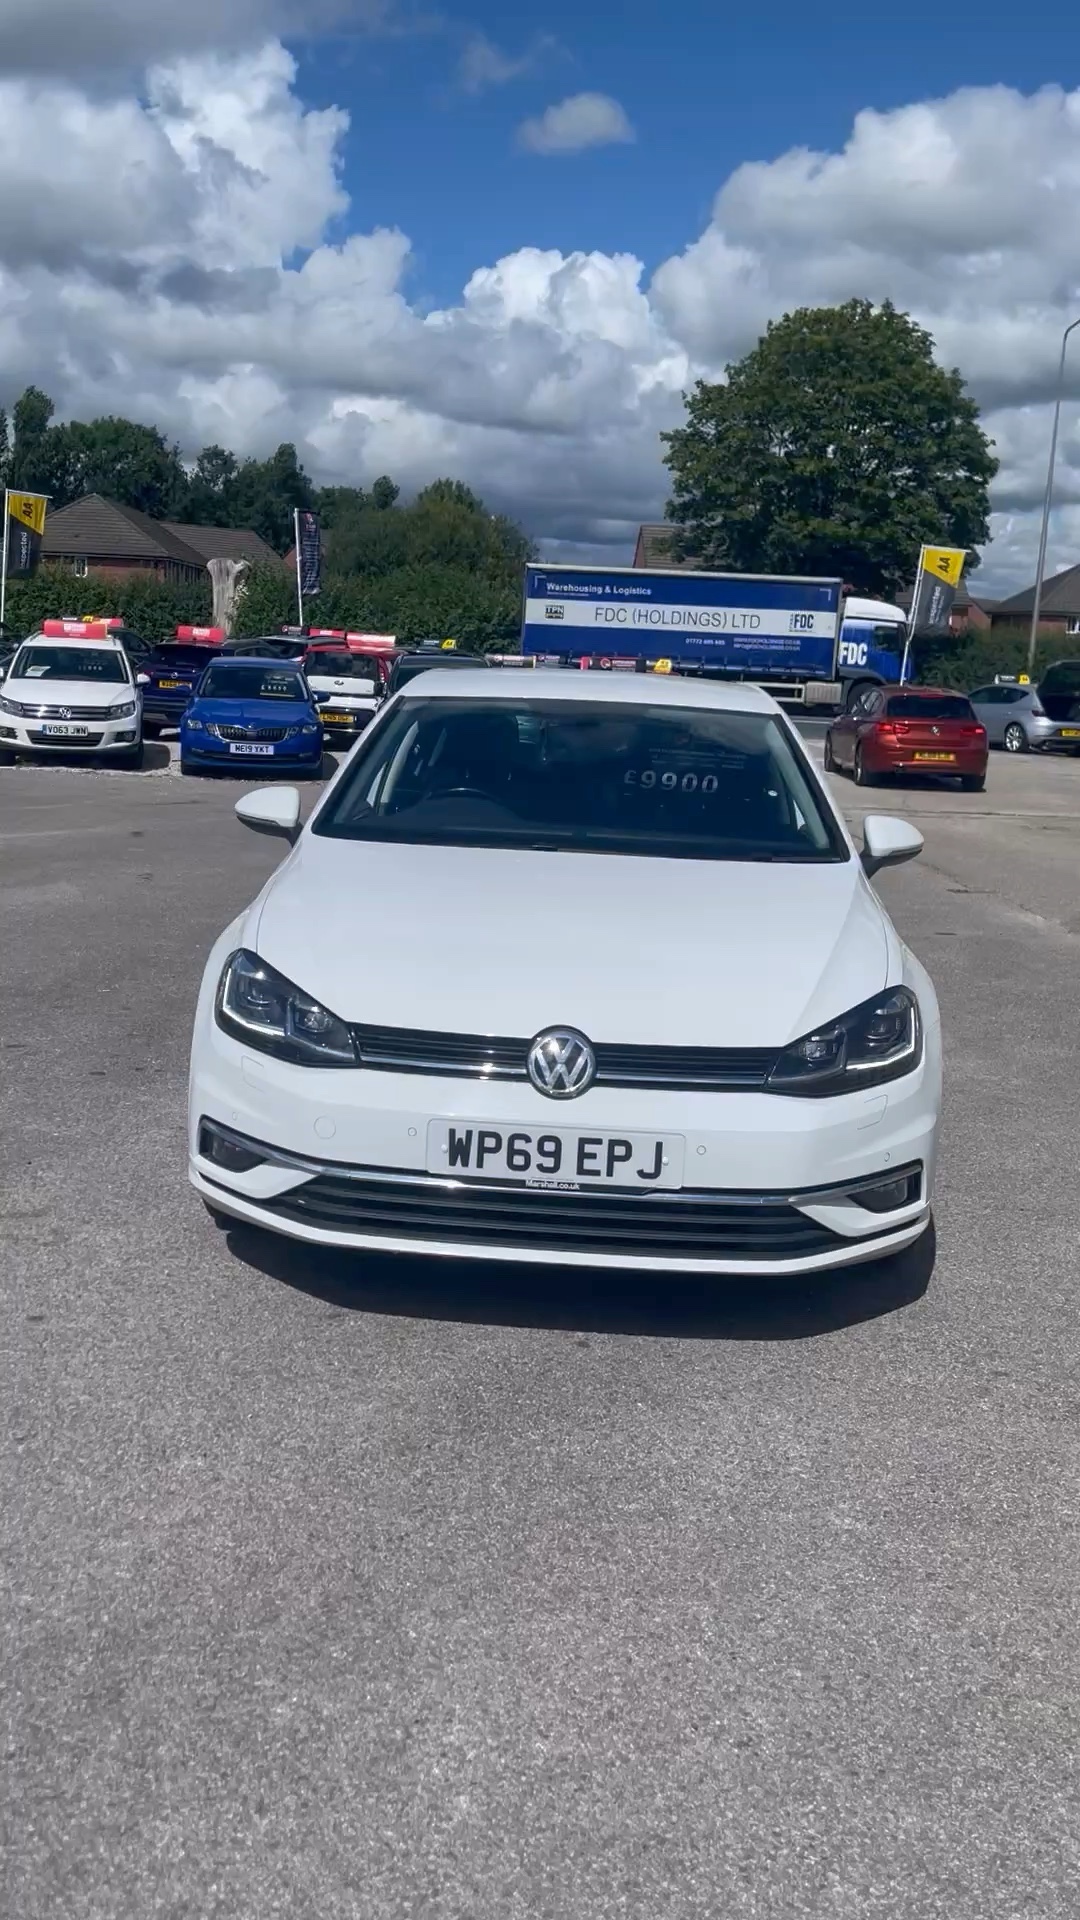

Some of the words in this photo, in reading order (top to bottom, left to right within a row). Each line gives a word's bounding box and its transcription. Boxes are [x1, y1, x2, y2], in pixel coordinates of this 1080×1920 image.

[22, 502, 33, 519] AA
[937, 556, 951, 574] AA
[546, 582, 603, 595] Warehousing
[604, 585, 612, 595] &
[613, 585, 652, 596] Logistics
[594, 607, 627, 623] FDC
[632, 609, 727, 629] (HOLDINGS)
[731, 613, 761, 629] LTD
[794, 613, 814, 629] FDC
[839, 641, 868, 666] FDC
[47, 726, 69, 735] VO63
[254, 745, 270, 754] YKT
[623, 769, 719, 793] £9900
[448, 1128, 563, 1174] WP69
[575, 1136, 664, 1180] EPJ
[525, 1178, 581, 1191] Marshall.co.uk
